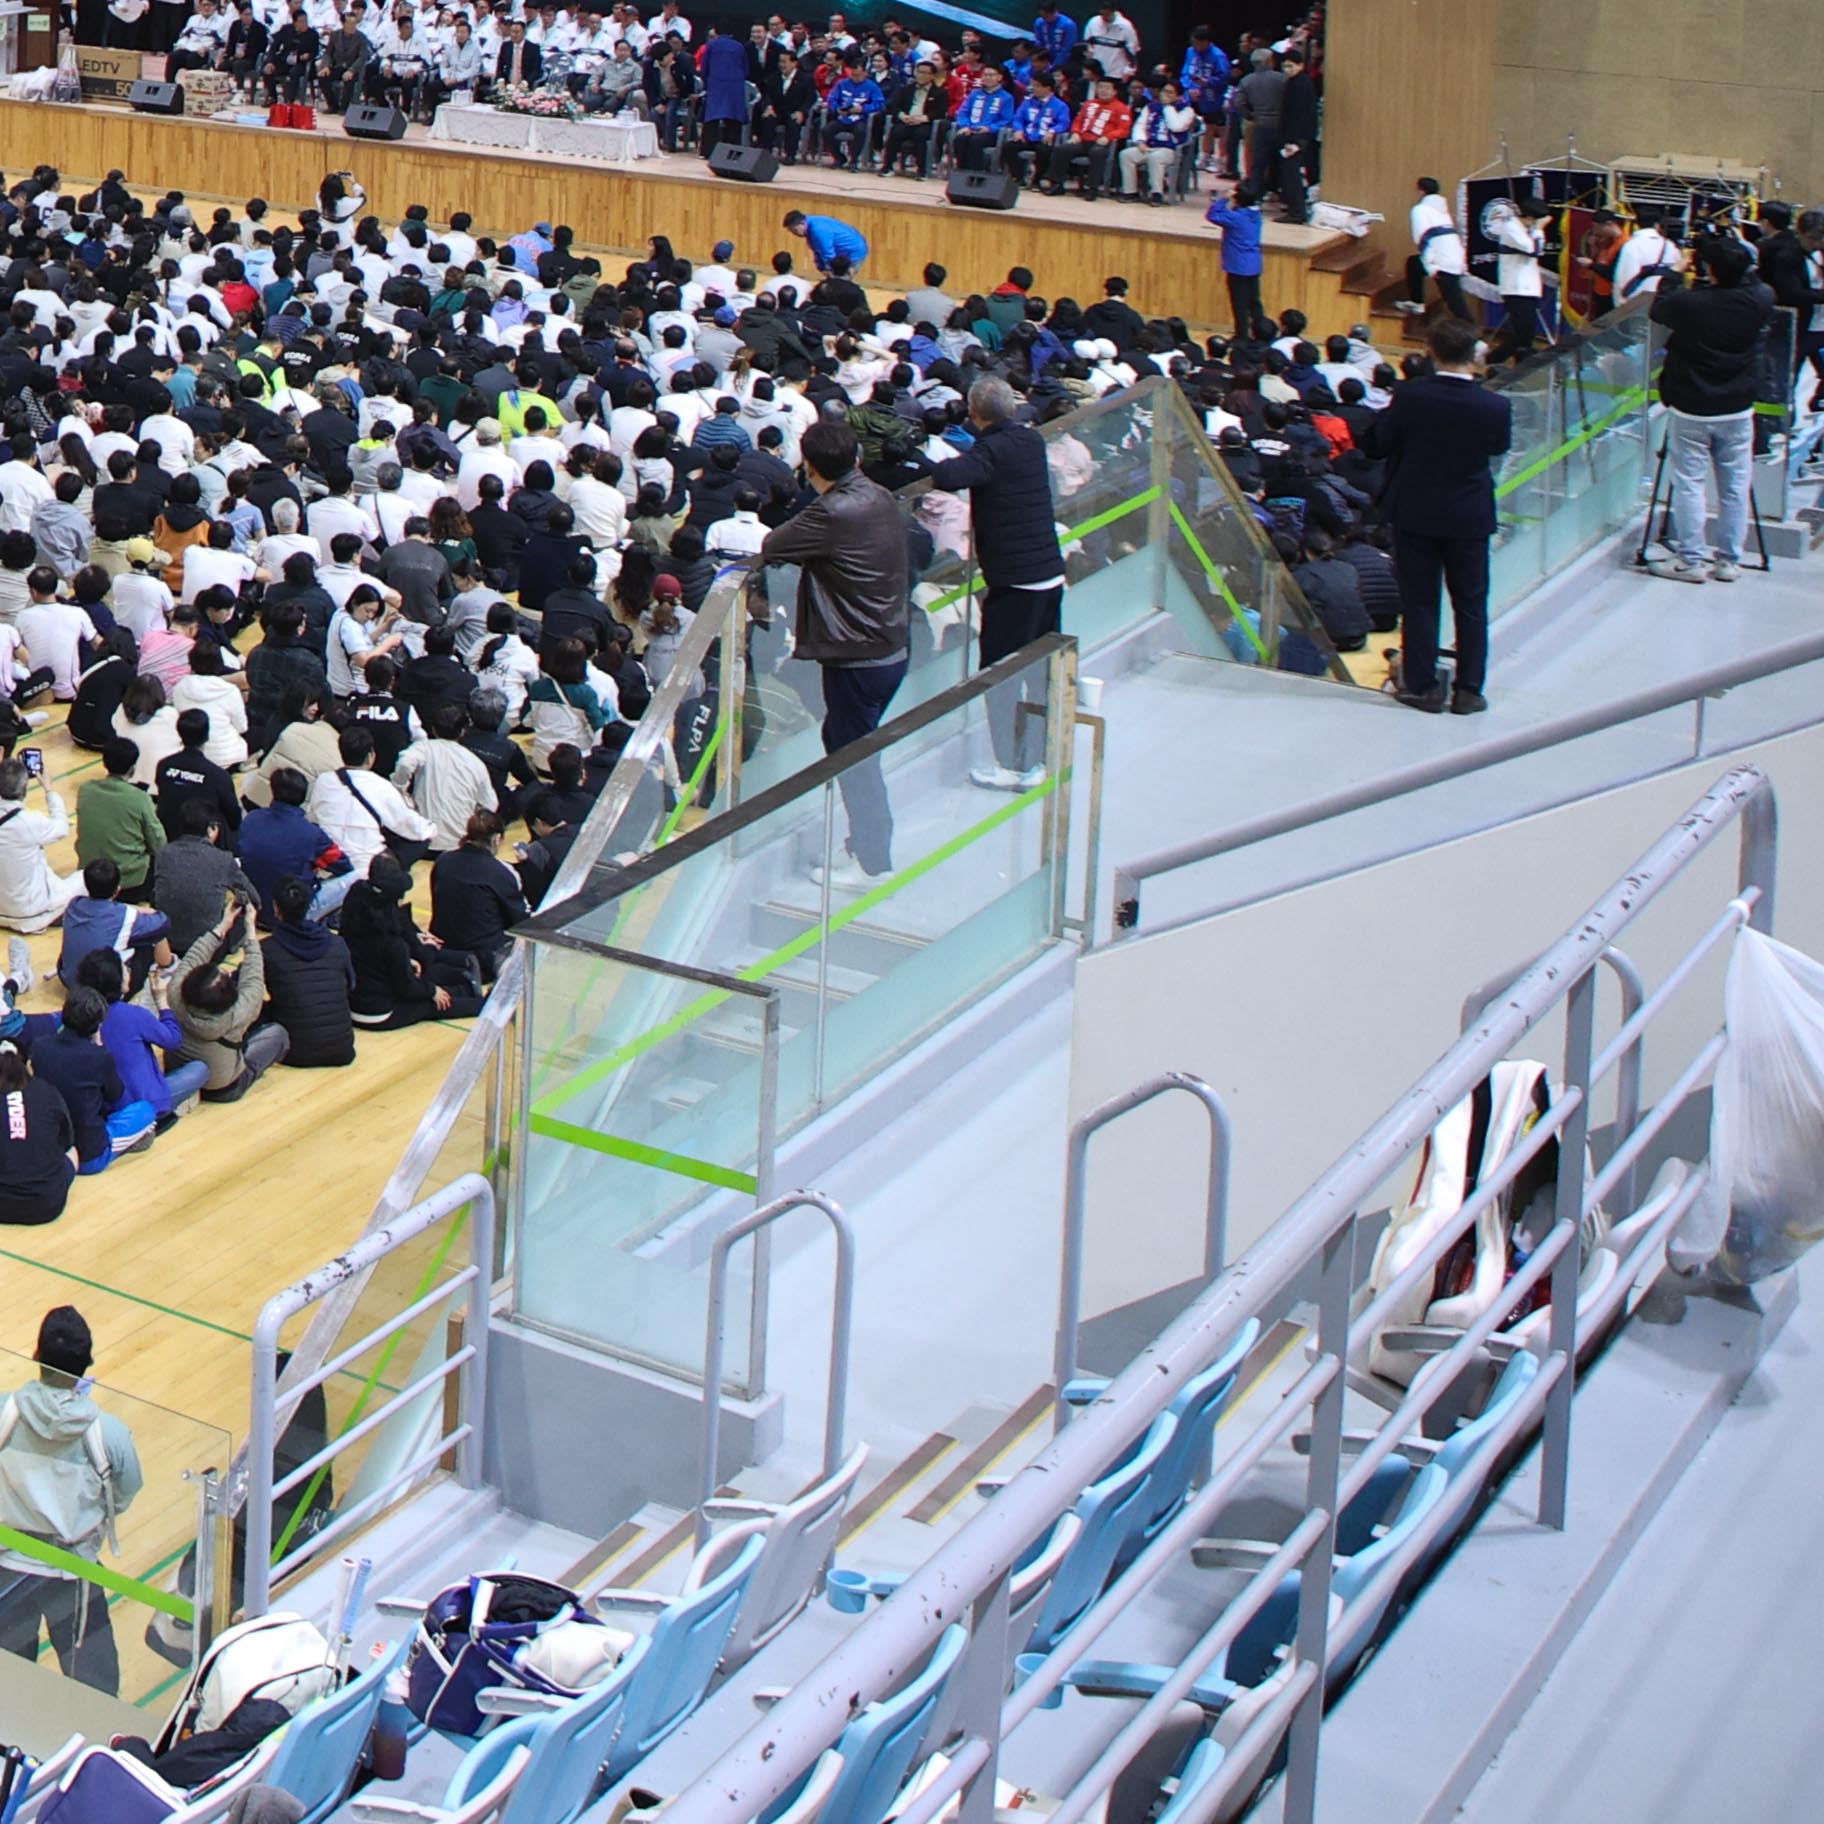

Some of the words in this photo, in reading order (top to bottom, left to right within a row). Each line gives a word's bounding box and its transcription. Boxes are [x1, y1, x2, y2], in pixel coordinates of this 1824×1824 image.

[283, 349, 312, 363] KOREA
[355, 705, 401, 722] FILA
[180, 770, 205, 785] YONEX
